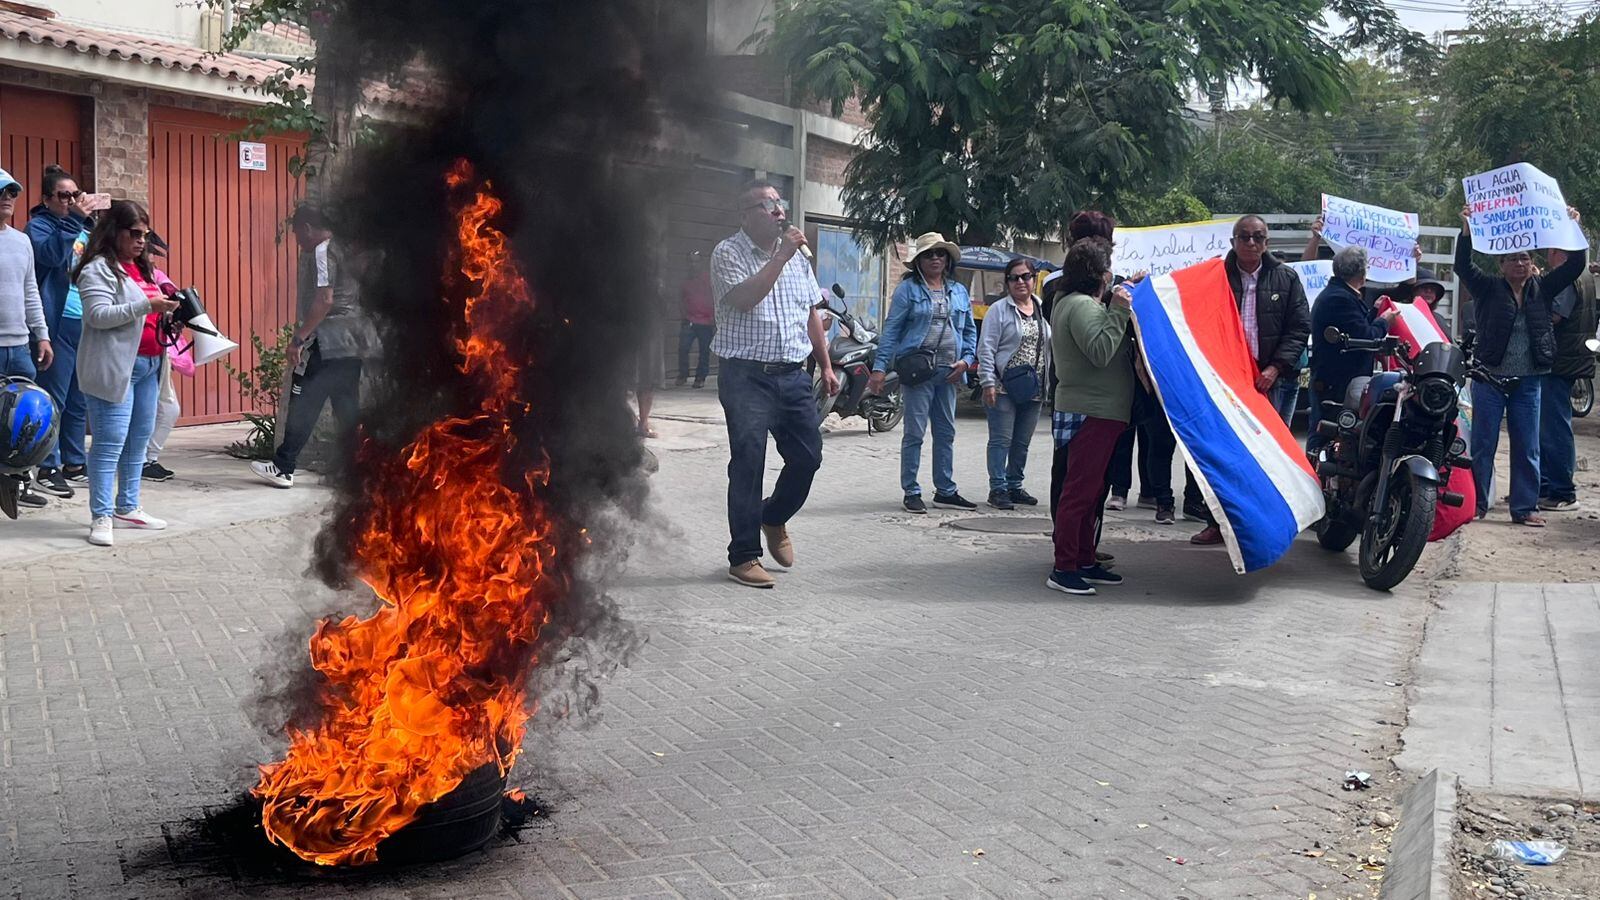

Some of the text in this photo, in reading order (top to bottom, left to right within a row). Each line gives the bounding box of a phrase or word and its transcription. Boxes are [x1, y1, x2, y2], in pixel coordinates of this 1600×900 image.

[1467, 169, 1521, 194] ¡EL AGUA
[1467, 182, 1528, 203] CONTAMINADA
[1482, 206, 1549, 225] SANEAMIENTO
[1344, 215, 1370, 231] Villa
[1372, 221, 1418, 240] Hermosa
[1471, 218, 1555, 237] UN DERECHO DE
[1113, 233, 1226, 261] La salud de
[1346, 230, 1382, 249] Gente
[1488, 232, 1538, 251] TODOS!
[1368, 256, 1410, 271] asura!
